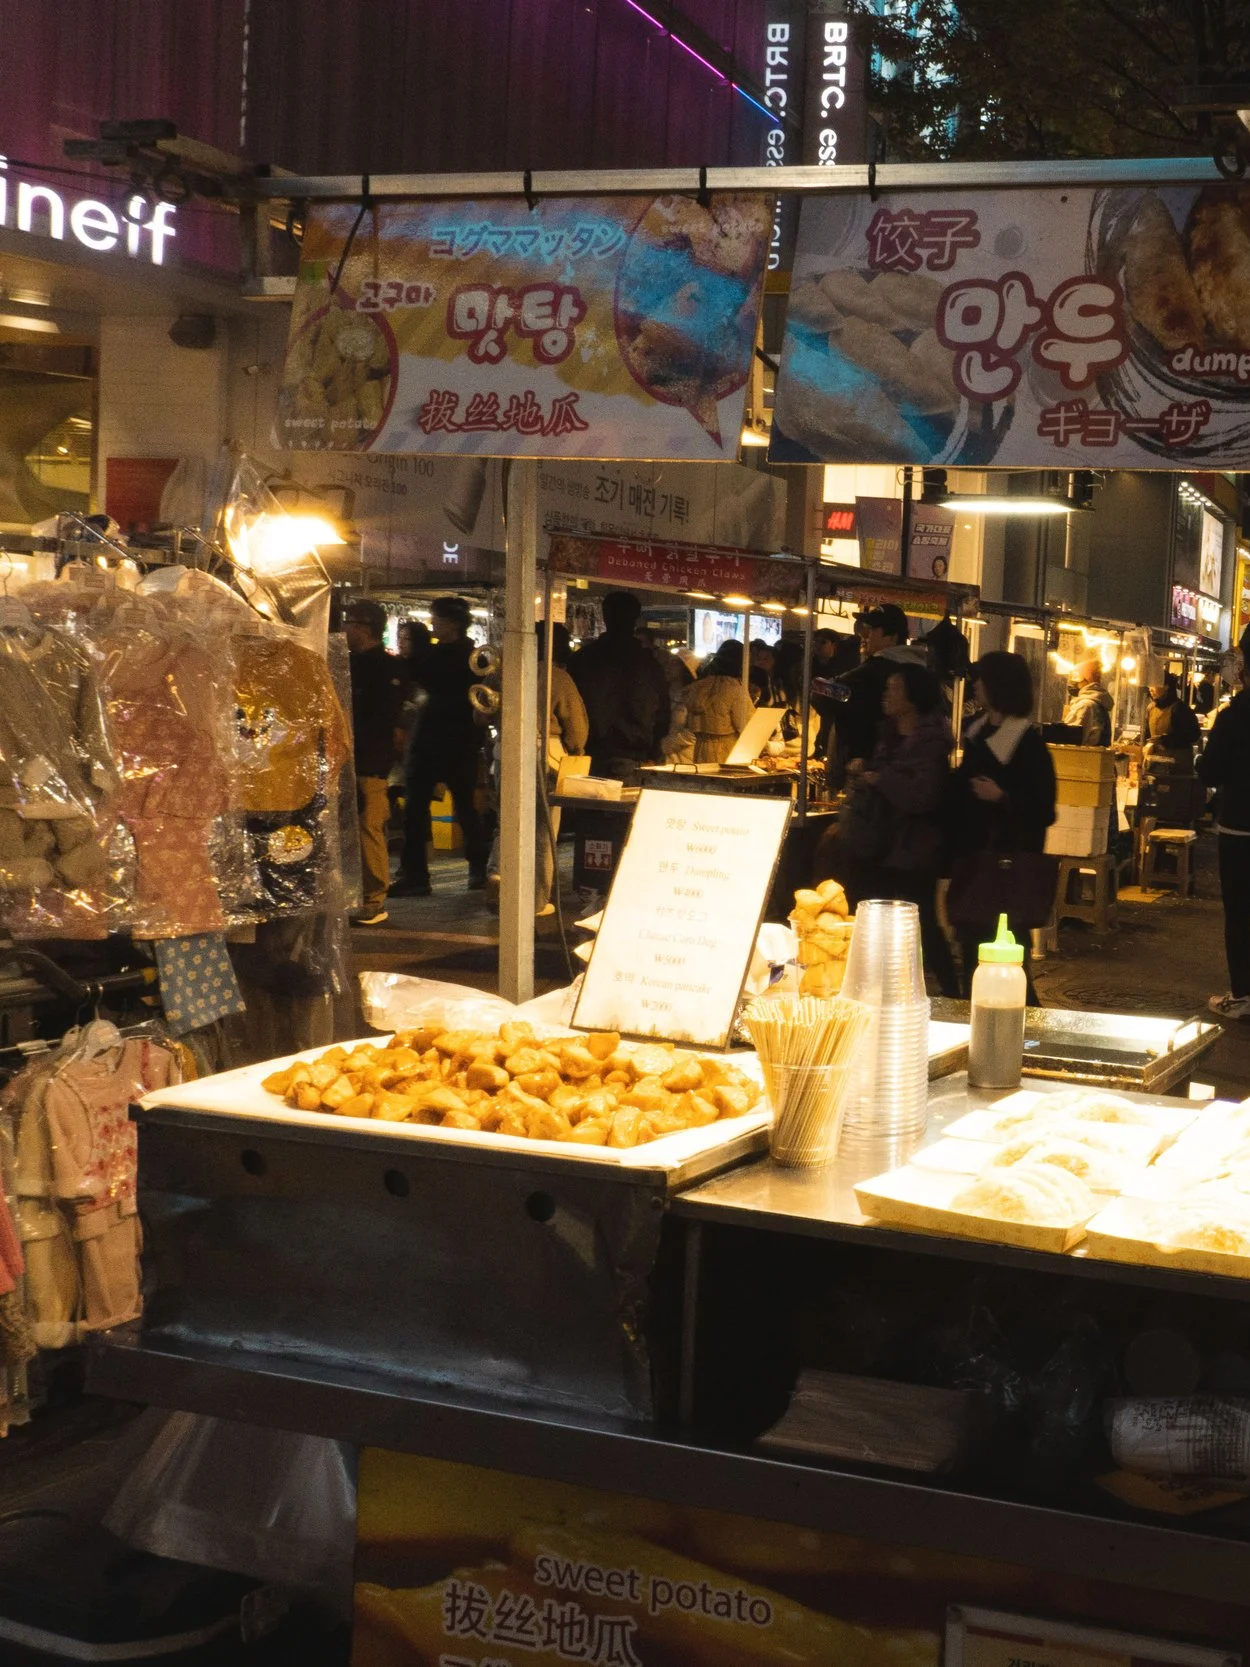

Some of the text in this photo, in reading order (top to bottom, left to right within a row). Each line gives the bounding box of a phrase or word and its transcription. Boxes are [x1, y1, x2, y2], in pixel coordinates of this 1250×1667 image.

[820, 21, 848, 119] BRTC.
[872, 214, 976, 269] 饺子
[355, 279, 436, 312] 고구마
[449, 285, 586, 361] 맛탕
[941, 276, 1126, 397] 만두
[420, 389, 589, 435] 拔丝地瓜
[1041, 404, 1207, 446] ギョーザ
[413, 457, 435, 478] 100
[594, 475, 625, 510] 조기
[629, 484, 656, 518] 매진
[608, 556, 746, 580] Deboned Chicken Claws
[692, 818, 720, 833] Sweet
[720, 823, 750, 837] potato
[640, 977, 673, 990] Korean
[674, 981, 713, 995] pancake
[534, 1555, 772, 1626] sweet potato
[445, 1582, 640, 1664] 拔丝地瓜
